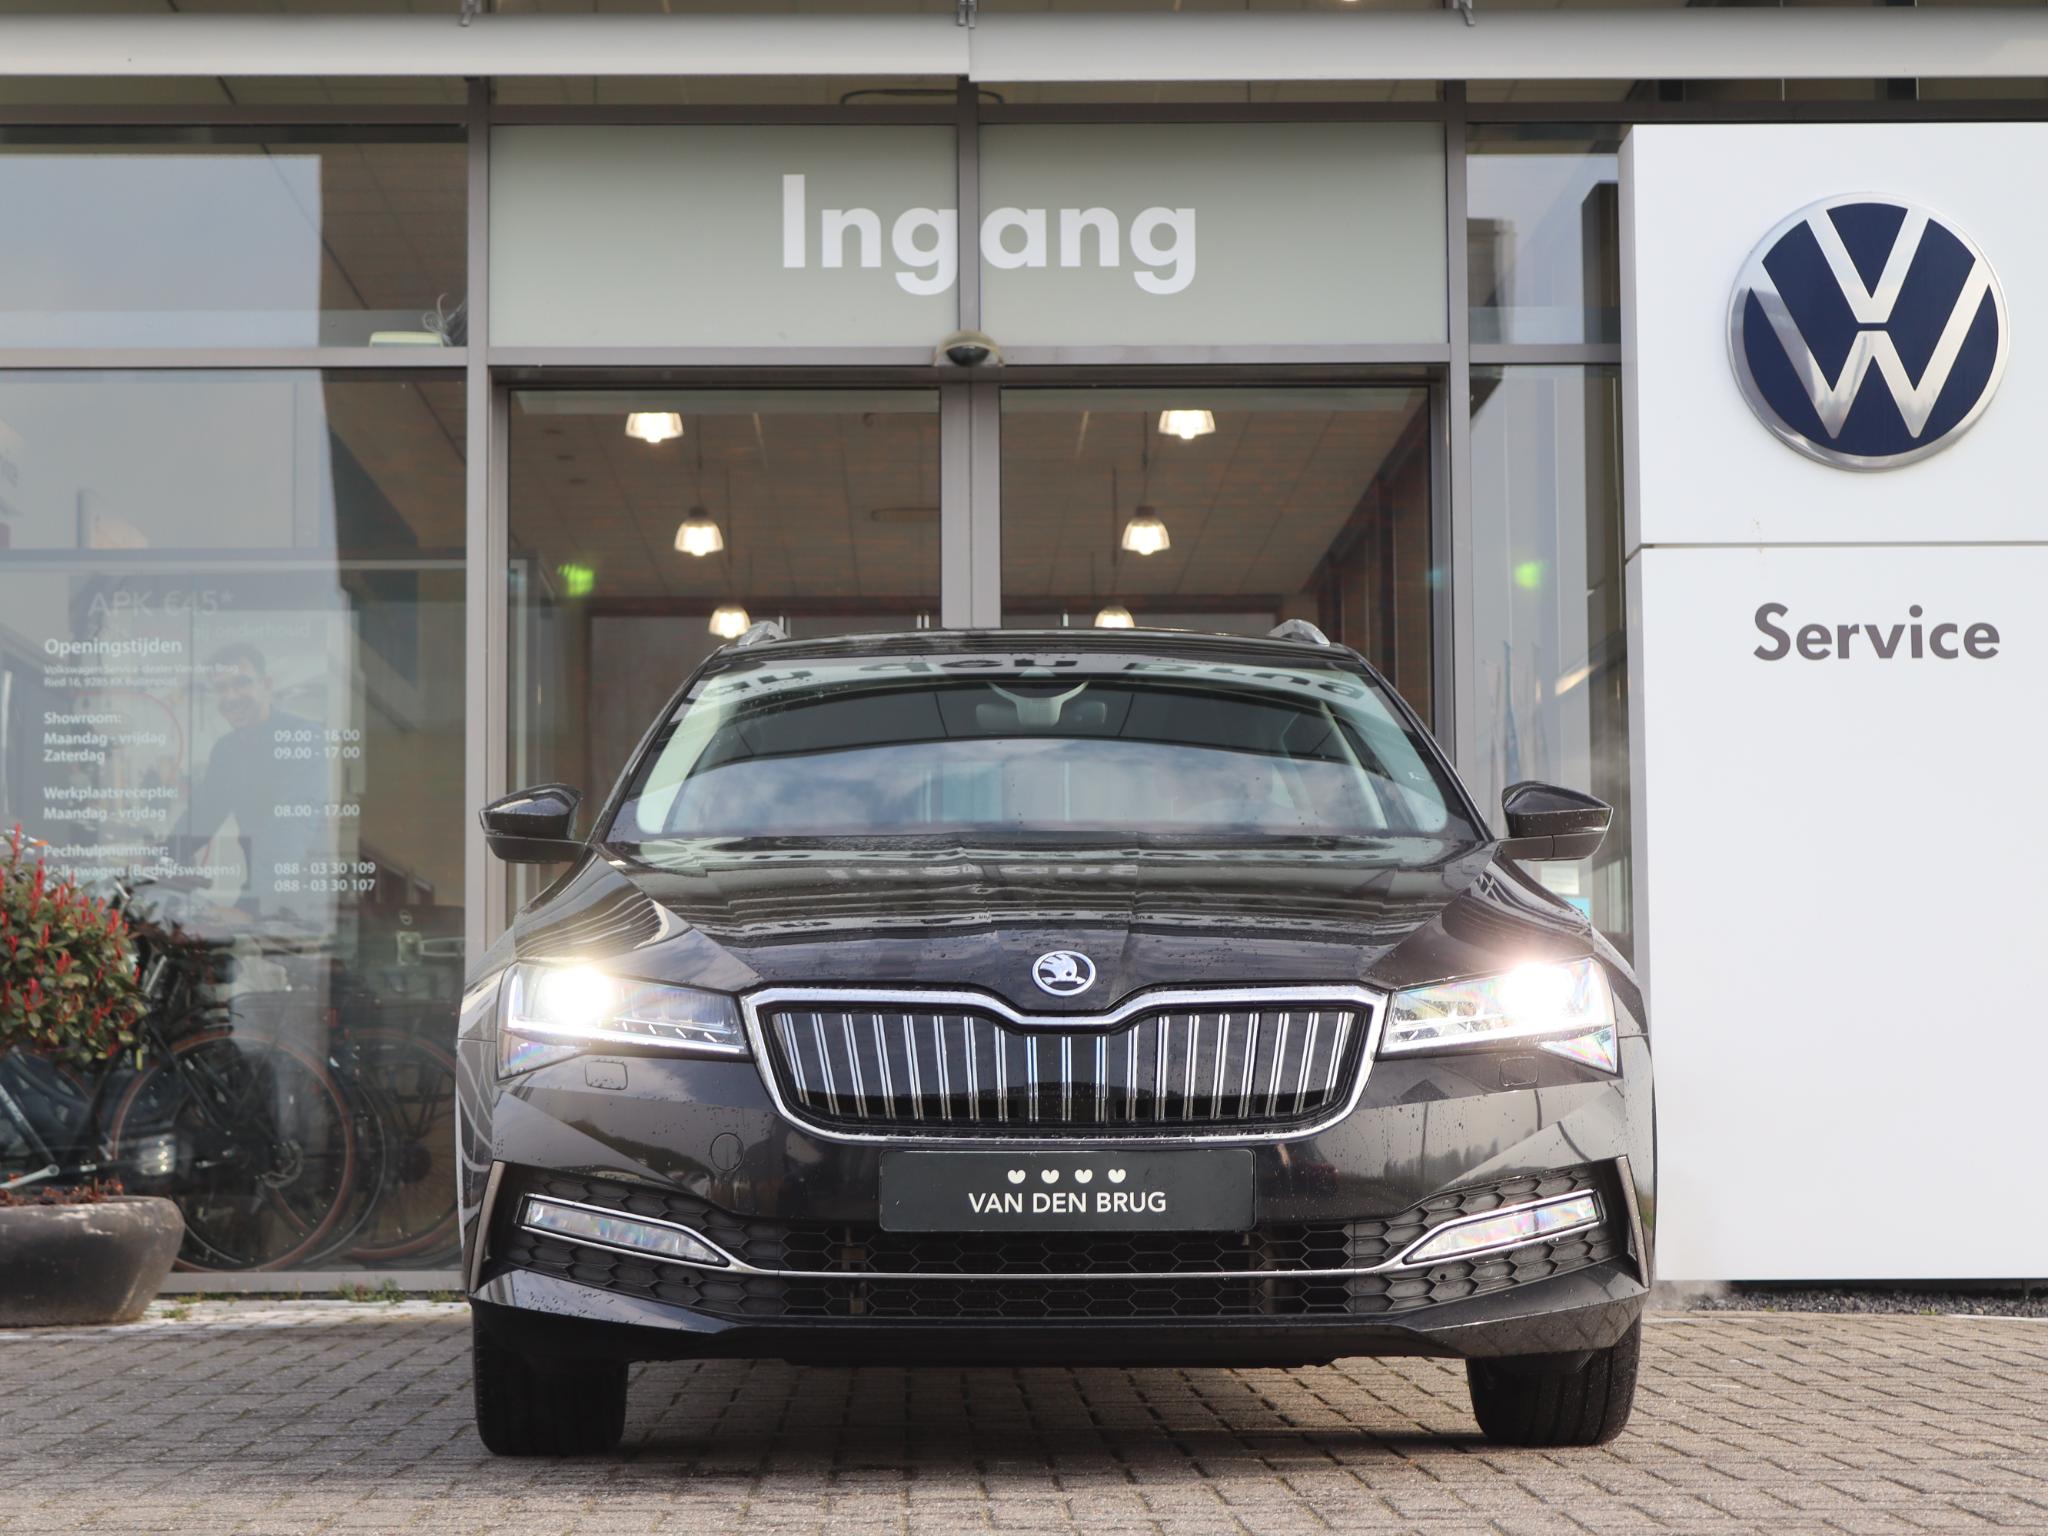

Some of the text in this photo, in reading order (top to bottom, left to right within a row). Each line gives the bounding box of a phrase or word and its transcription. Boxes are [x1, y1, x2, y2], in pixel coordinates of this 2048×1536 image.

[783, 173, 1197, 296] Ingang
[88, 591, 154, 617] APK
[1753, 602, 2000, 662] Service
[44, 637, 183, 658] Openingstijden
[44, 677, 67, 688] Ried
[44, 711, 121, 725] Showroom:
[44, 732, 107, 748] Maandag
[119, 732, 166, 747] vrijdag
[274, 730, 312, 742] 09.00
[44, 748, 105, 766] Zaterdag
[274, 747, 312, 759] 09.00
[43, 786, 178, 802] Werkplaatsreceptie:
[44, 806, 107, 822] Maandag
[119, 806, 166, 821] vrijdag
[274, 804, 312, 817] 08.00
[43, 844, 169, 858] Pechhulpnummer:
[274, 862, 300, 875] 088
[310, 862, 327, 875] 03
[331, 862, 348, 875] 30
[351, 862, 376, 875] 109
[274, 879, 300, 892] 088
[310, 879, 327, 892] 03
[331, 879, 348, 892] 30
[351, 879, 376, 892] 107
[968, 1191, 1167, 1214] VAN DEN BRUG
